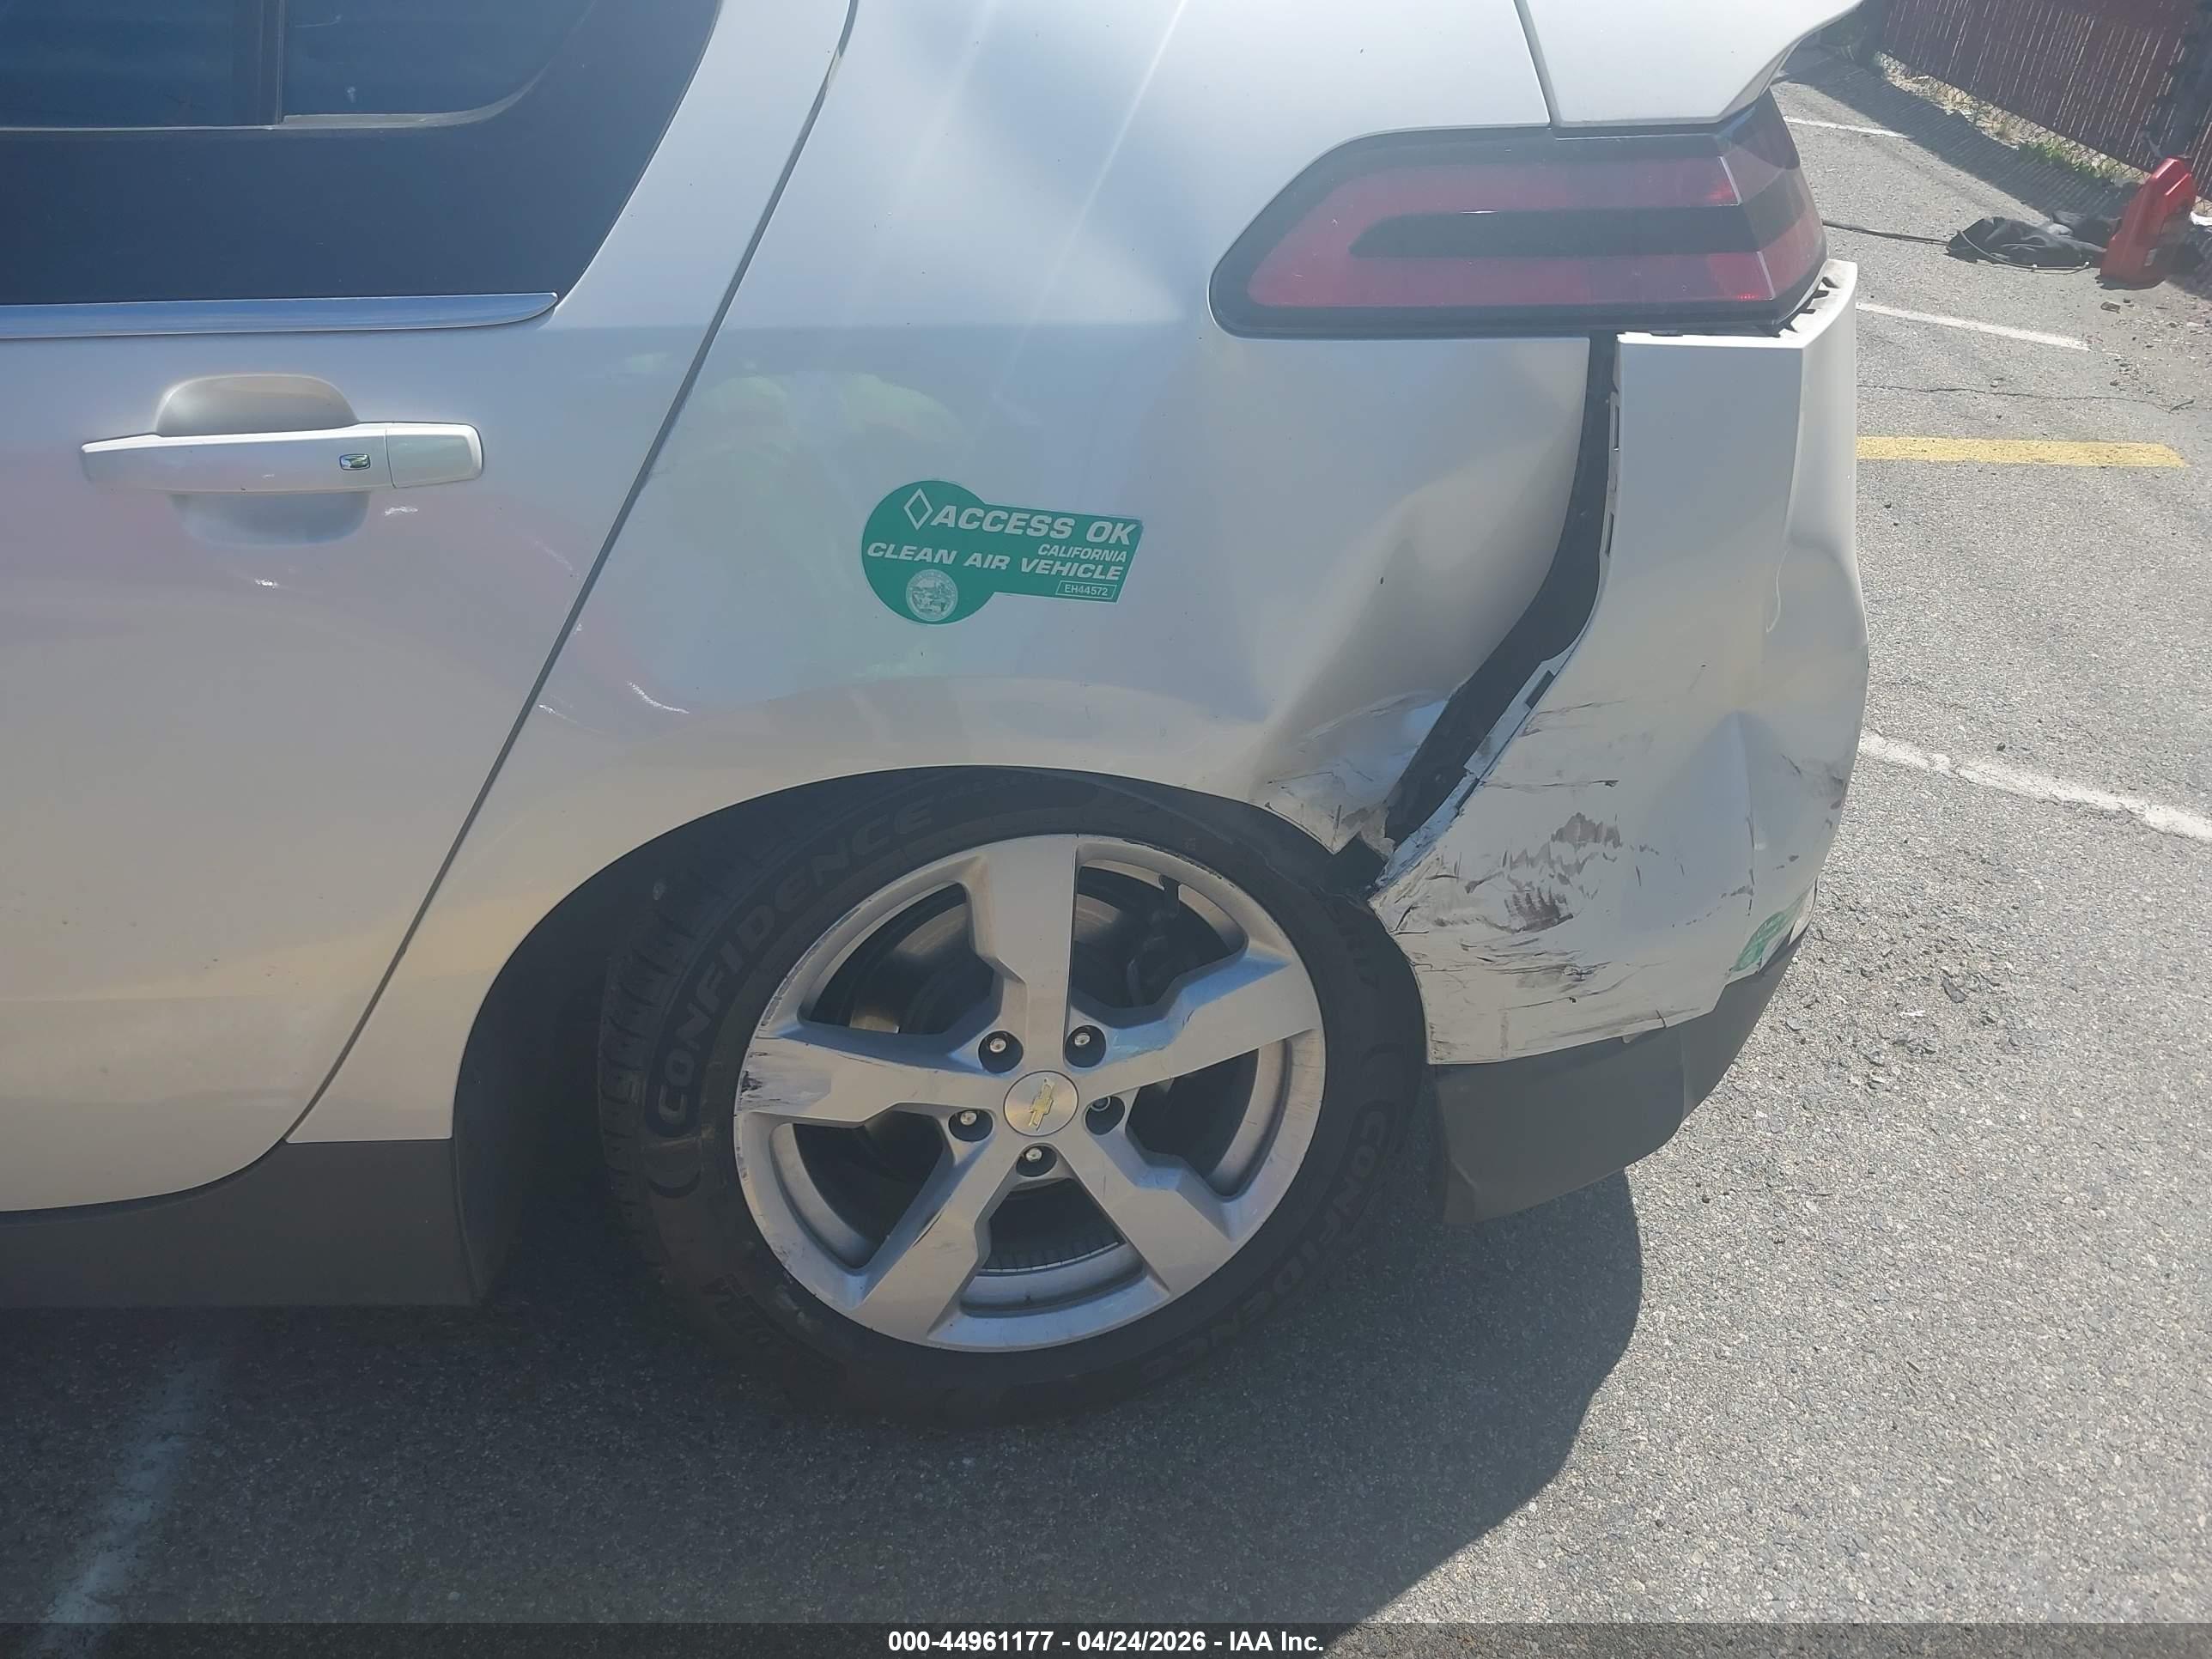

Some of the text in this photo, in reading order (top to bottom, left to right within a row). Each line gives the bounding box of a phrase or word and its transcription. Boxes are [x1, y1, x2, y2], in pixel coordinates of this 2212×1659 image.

[931, 505, 1137, 545] ACCESS OK
[867, 542, 1123, 580] CLEAN AIR VEHICLE
[1037, 544, 1127, 563] CALIFORNIA
[1064, 583, 1109, 597] EH44572
[657, 794, 935, 1125] CONFIDENCE
